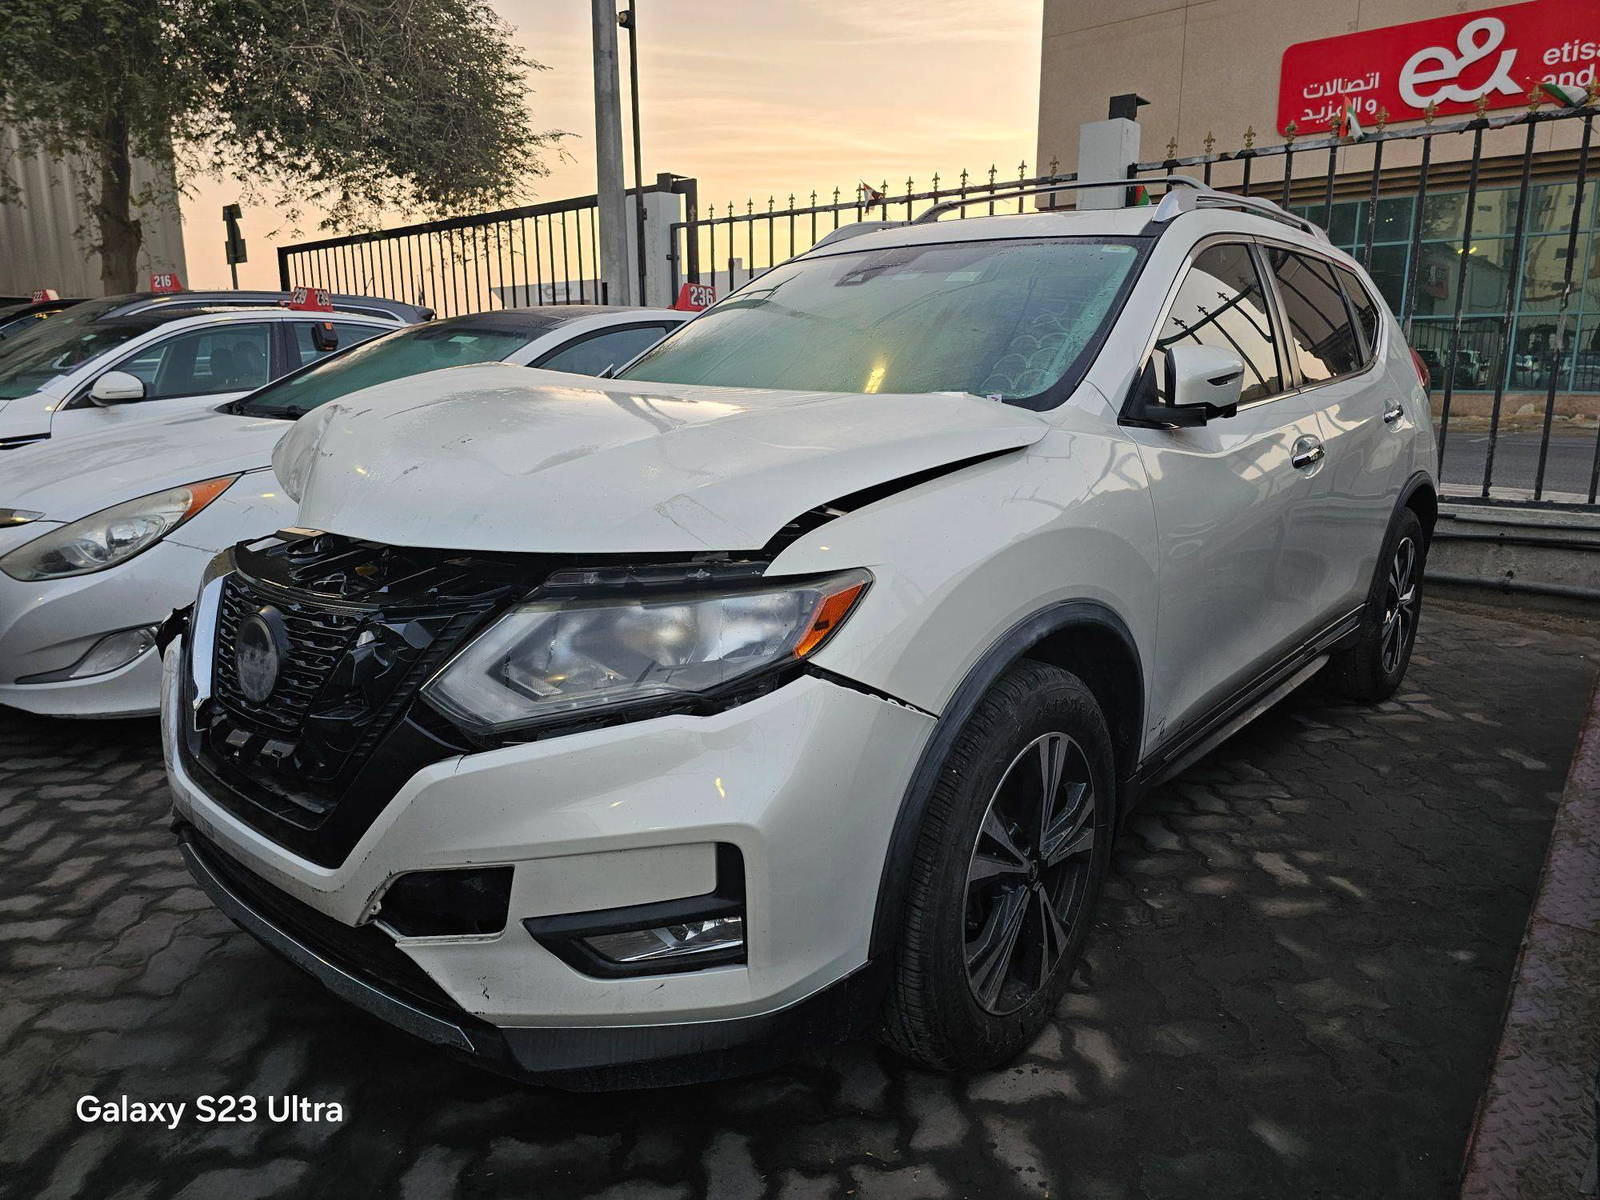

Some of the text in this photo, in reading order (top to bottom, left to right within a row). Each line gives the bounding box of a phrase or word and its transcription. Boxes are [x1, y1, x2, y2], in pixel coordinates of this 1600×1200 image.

[1399, 17, 1523, 108] e&
[1543, 40, 1600, 65] etis
[1303, 72, 1379, 98] اتصالات
[1541, 63, 1595, 87] and
[1365, 99, 1377, 115] و
[154, 275, 171, 288] 216
[691, 286, 713, 306] 236
